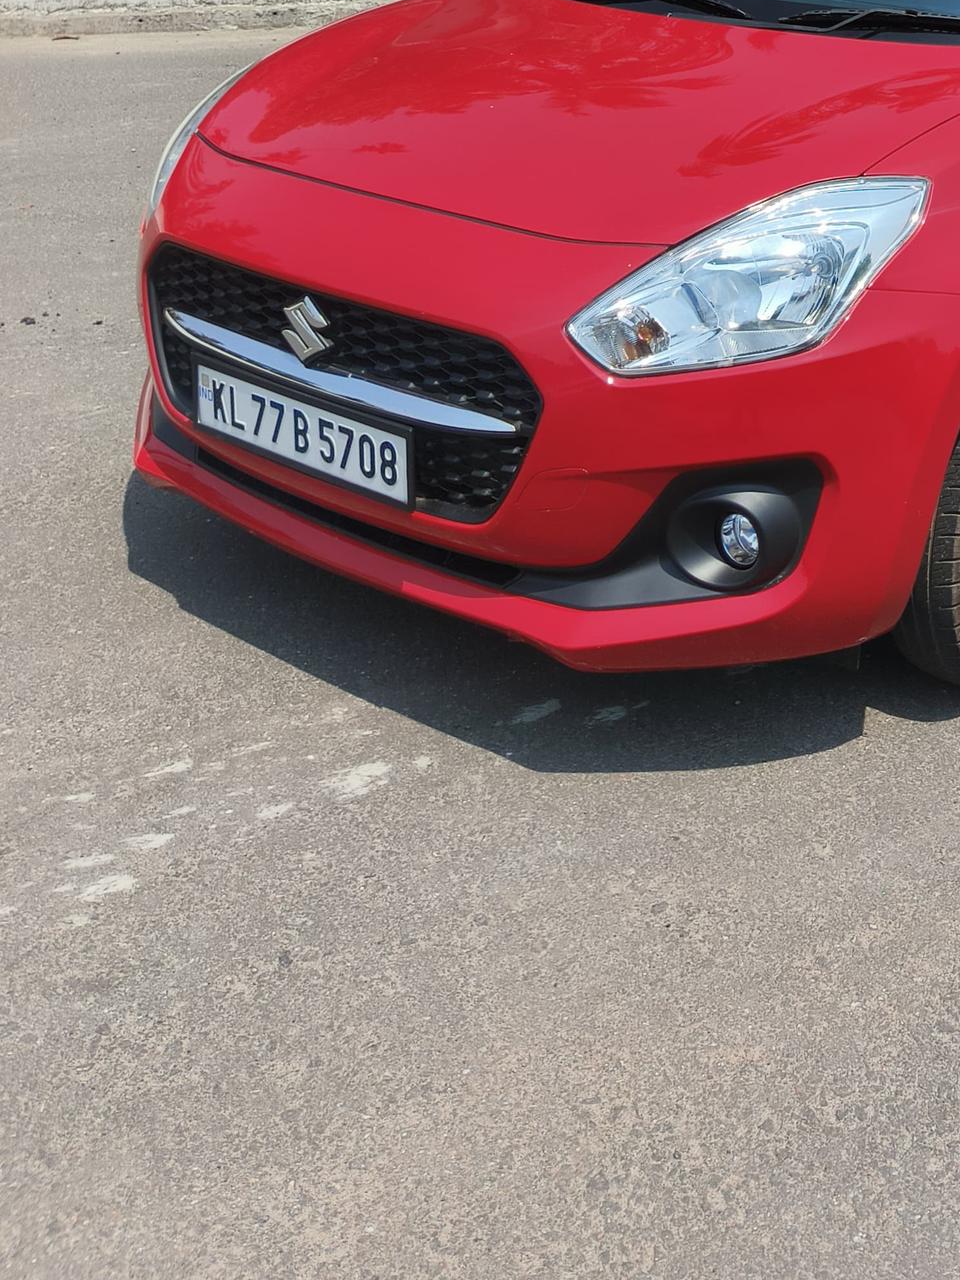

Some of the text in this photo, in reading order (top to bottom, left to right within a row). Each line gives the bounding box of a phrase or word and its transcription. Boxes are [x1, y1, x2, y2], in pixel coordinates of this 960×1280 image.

[199, 385, 213, 401] IND
[212, 379, 397, 486] KL 77 B 5708
